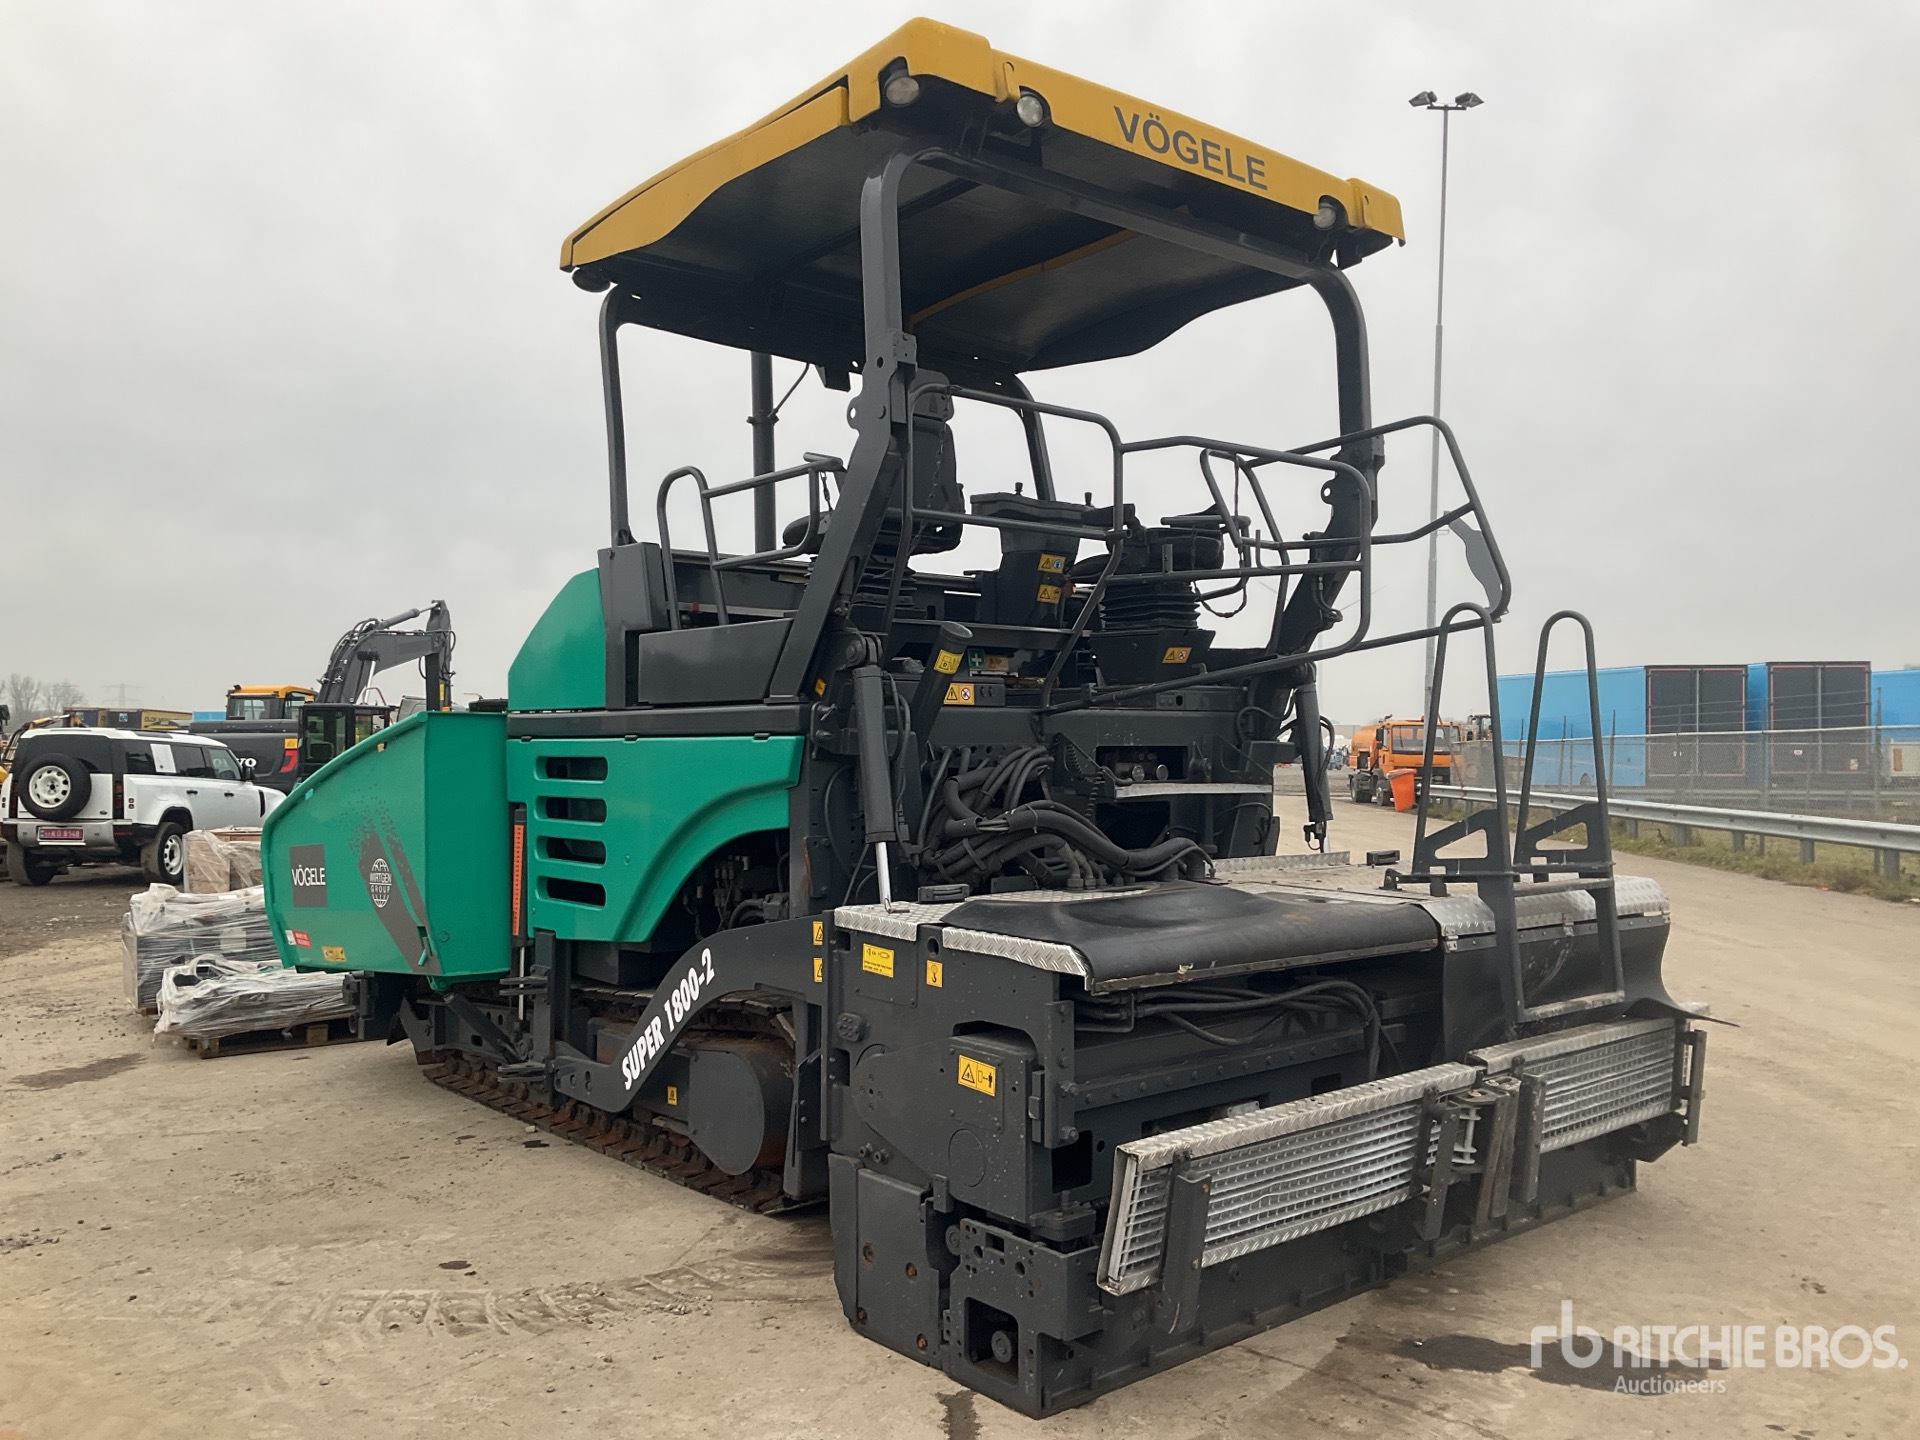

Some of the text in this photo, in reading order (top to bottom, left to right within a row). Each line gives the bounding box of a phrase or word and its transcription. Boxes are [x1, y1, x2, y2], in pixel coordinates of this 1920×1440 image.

[1113, 105, 1268, 191] VÖGELE
[291, 864, 326, 887] VÖGELE
[369, 872, 392, 883] WIRTGEN
[371, 884, 391, 893] GROUP
[621, 948, 715, 1090] SUPER 1800-2
